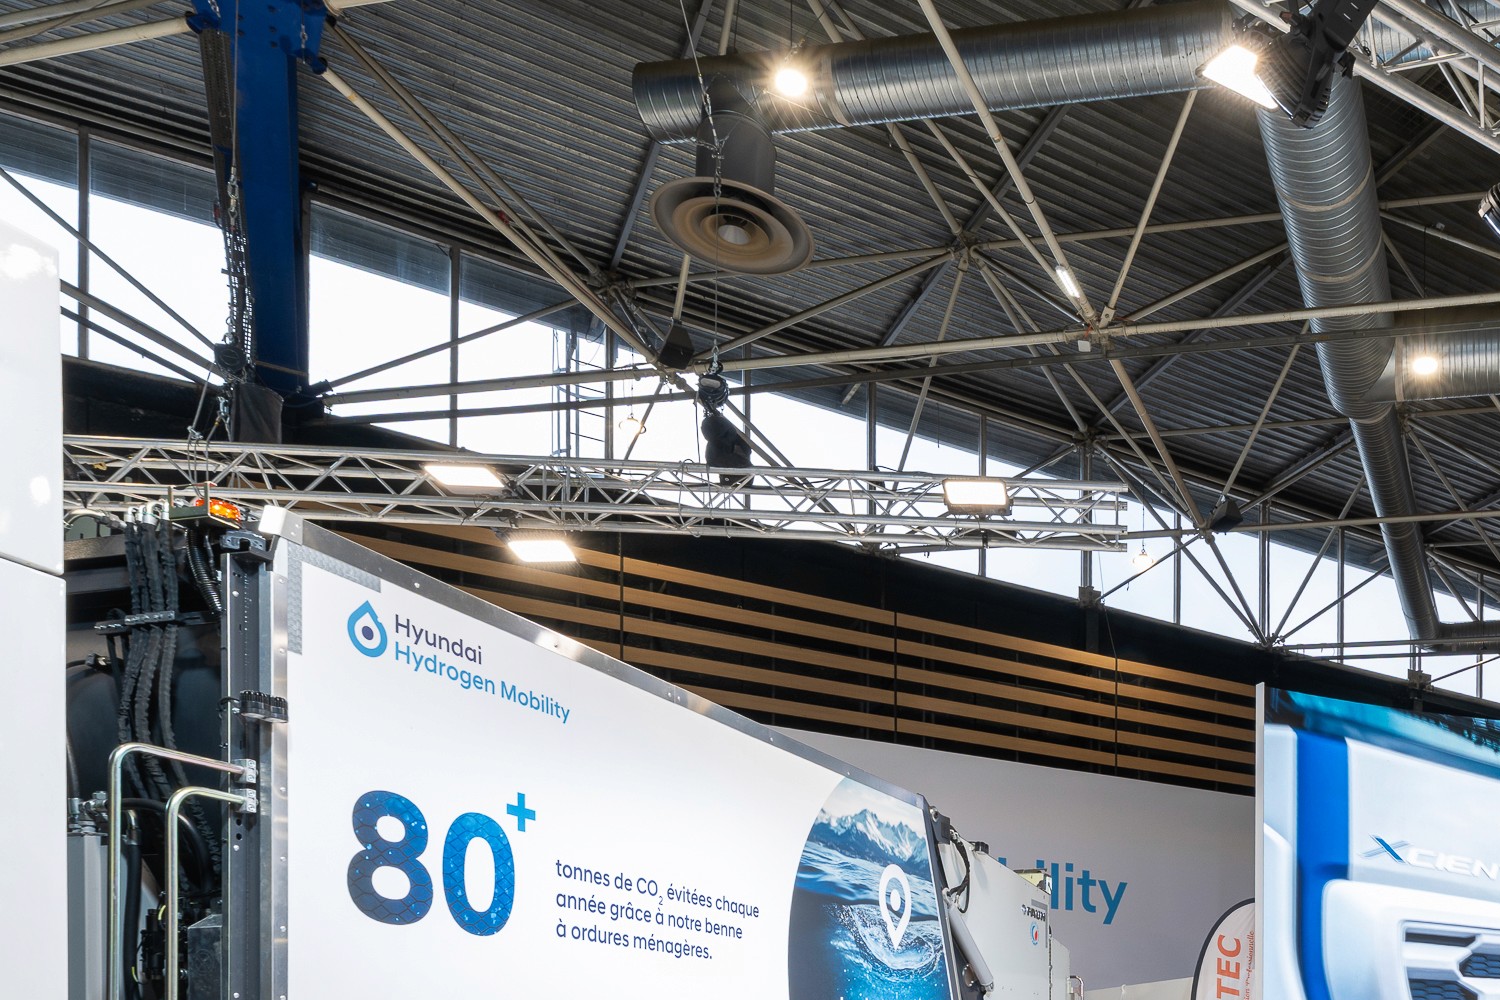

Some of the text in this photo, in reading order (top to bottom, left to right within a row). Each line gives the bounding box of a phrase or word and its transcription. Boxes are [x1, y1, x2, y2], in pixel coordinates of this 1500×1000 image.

[395, 613, 482, 665] Hyundai
[395, 641, 571, 724] Hydrogen Mobility
[555, 859, 611, 887] tonnes
[614, 873, 633, 891] de
[666, 883, 713, 908] évitées
[715, 896, 760, 919] chaque
[555, 893, 743, 939] année grâce à notre benne
[555, 918, 713, 960] à ordures ménagères.
